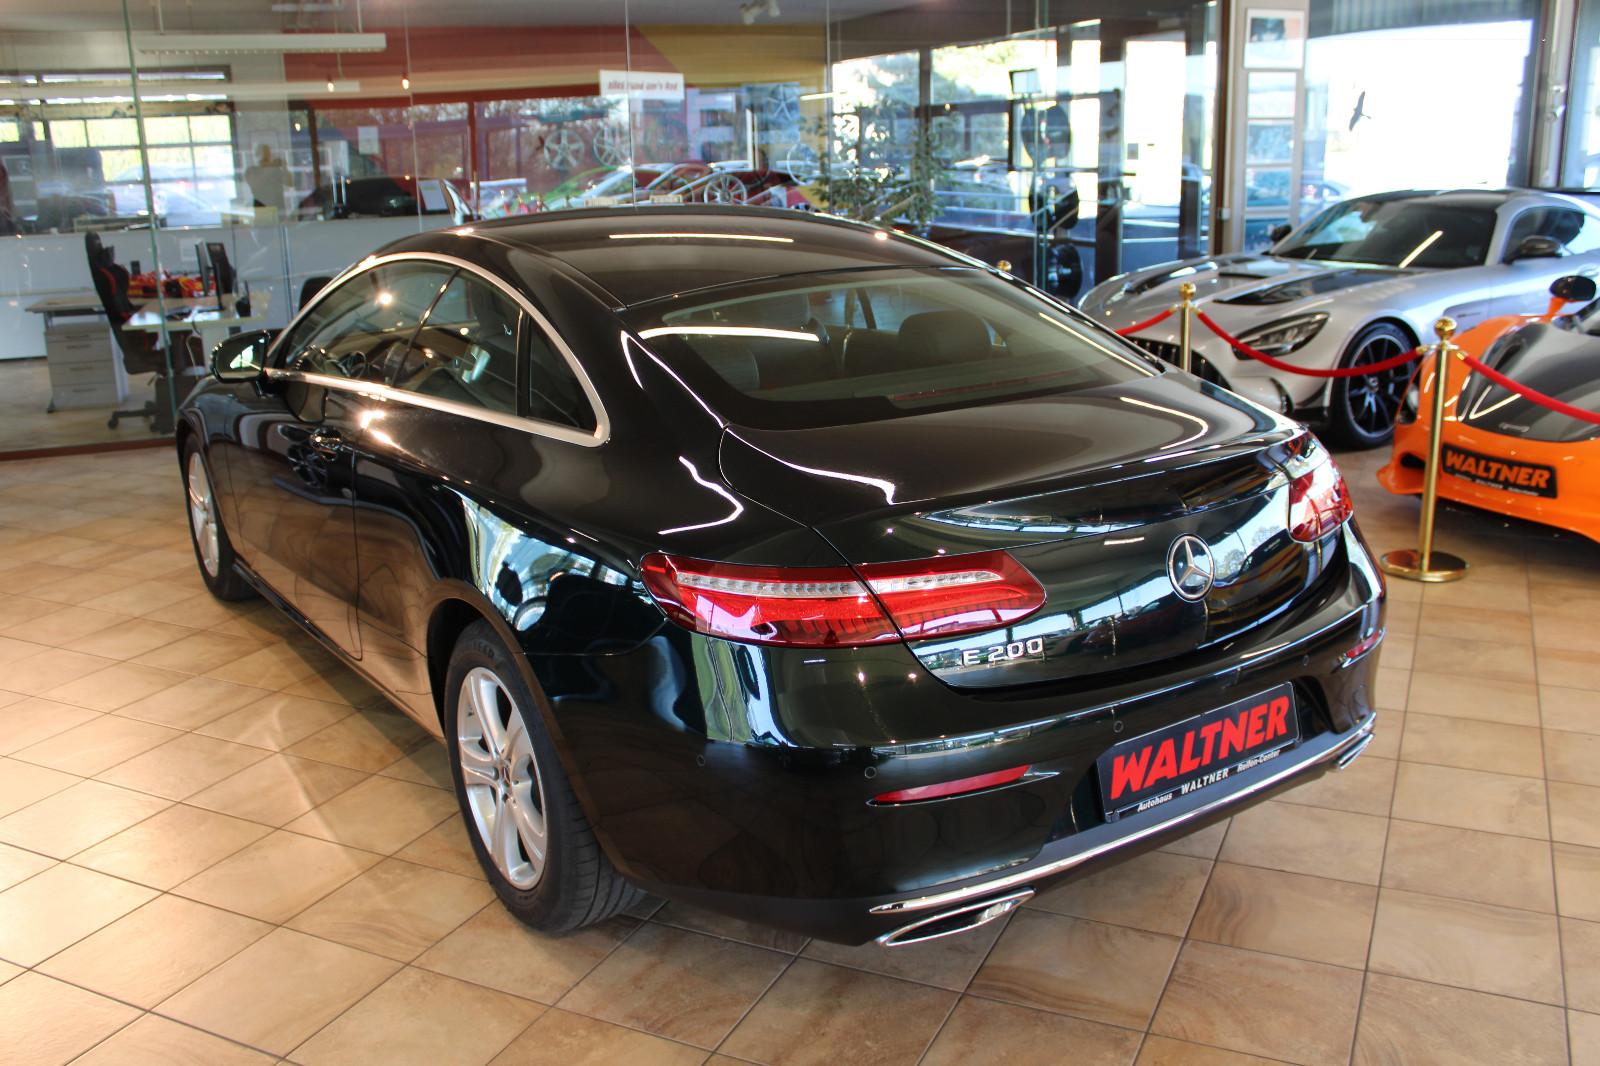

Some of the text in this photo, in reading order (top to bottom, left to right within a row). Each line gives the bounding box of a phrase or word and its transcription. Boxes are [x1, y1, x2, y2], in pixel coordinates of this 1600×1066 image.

[1445, 450, 1551, 488] WALTNER
[963, 637, 1043, 666] E 200
[1110, 696, 1290, 800] WALTNER
[1137, 749, 1281, 813] Autohaus WALTNER Reifen-Center
